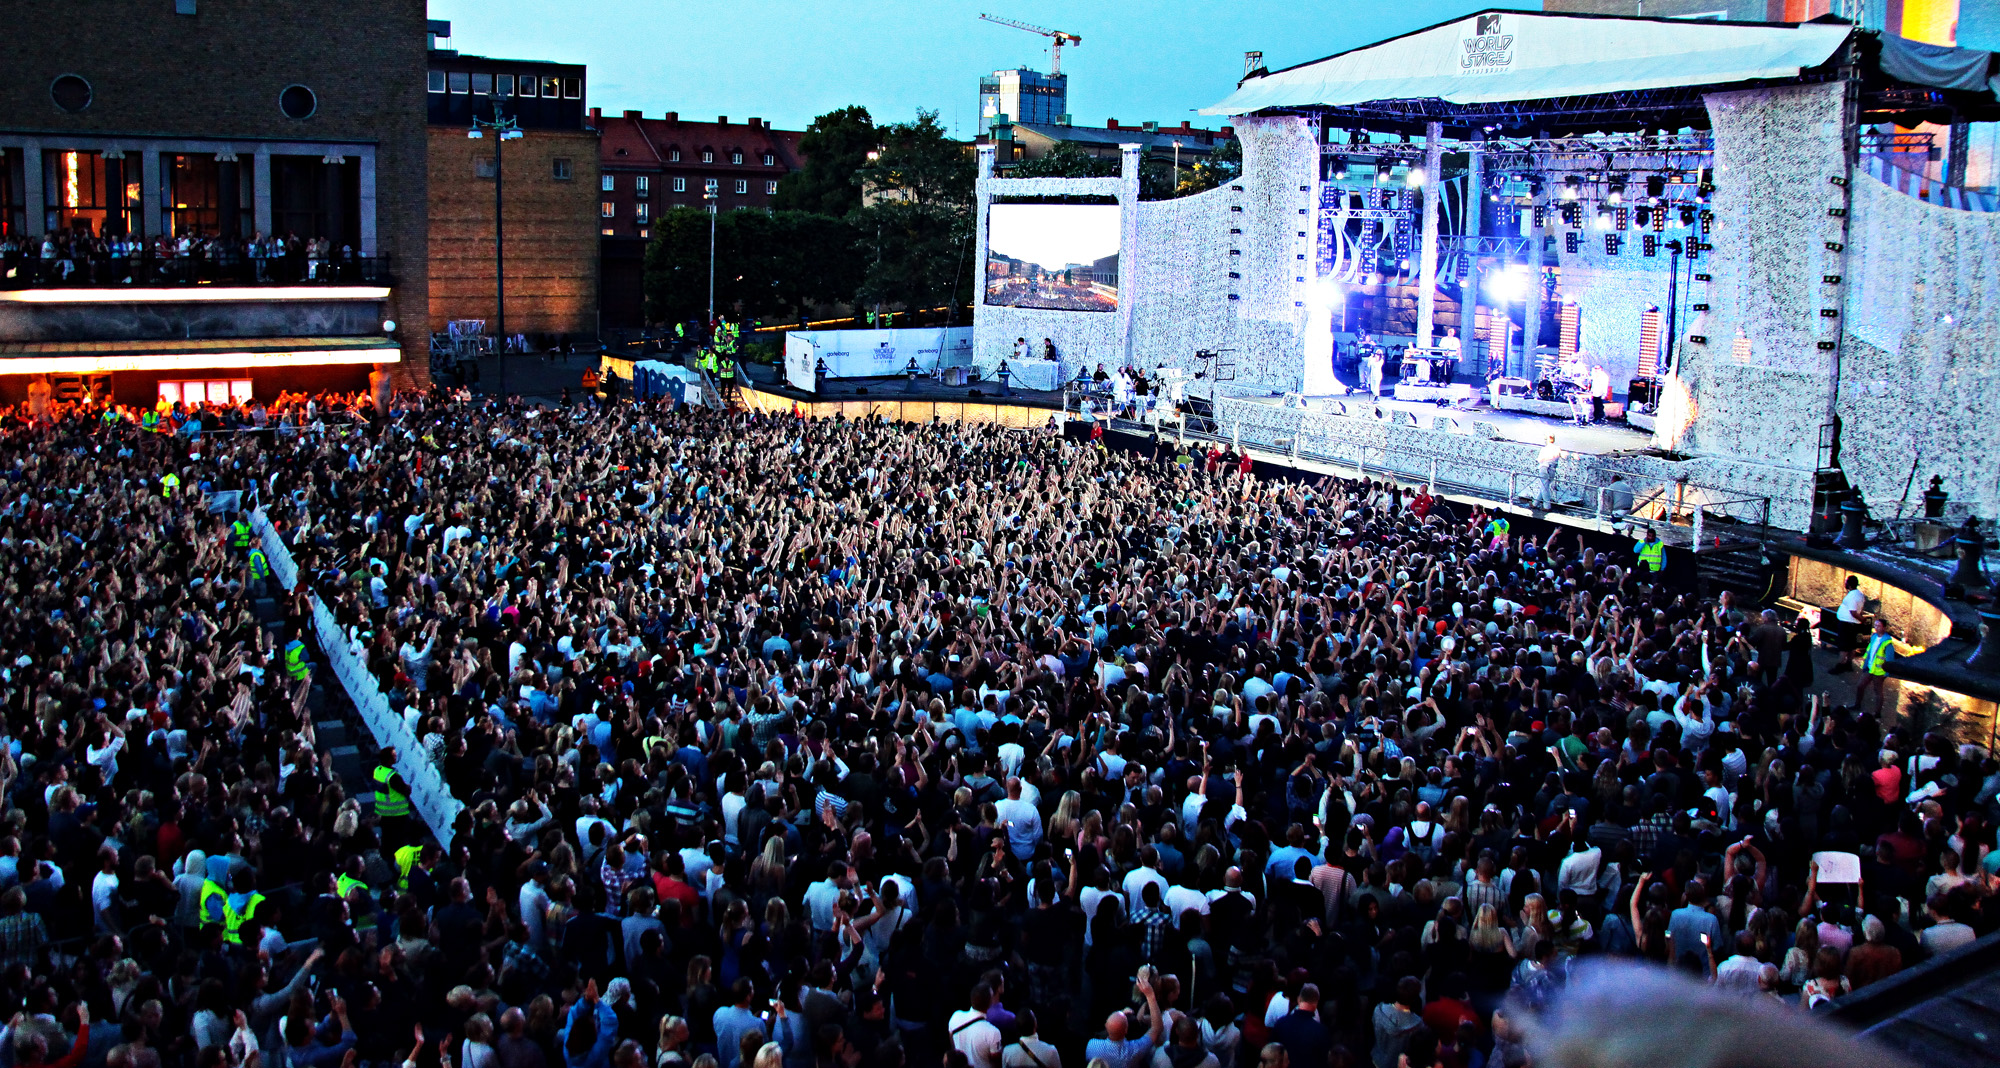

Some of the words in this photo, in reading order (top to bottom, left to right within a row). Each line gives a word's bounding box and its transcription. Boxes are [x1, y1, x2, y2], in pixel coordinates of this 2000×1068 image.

[1477, 14, 1502, 35] MTV
[1463, 35, 1513, 53] WORLD
[1461, 51, 1512, 68] STAGE
